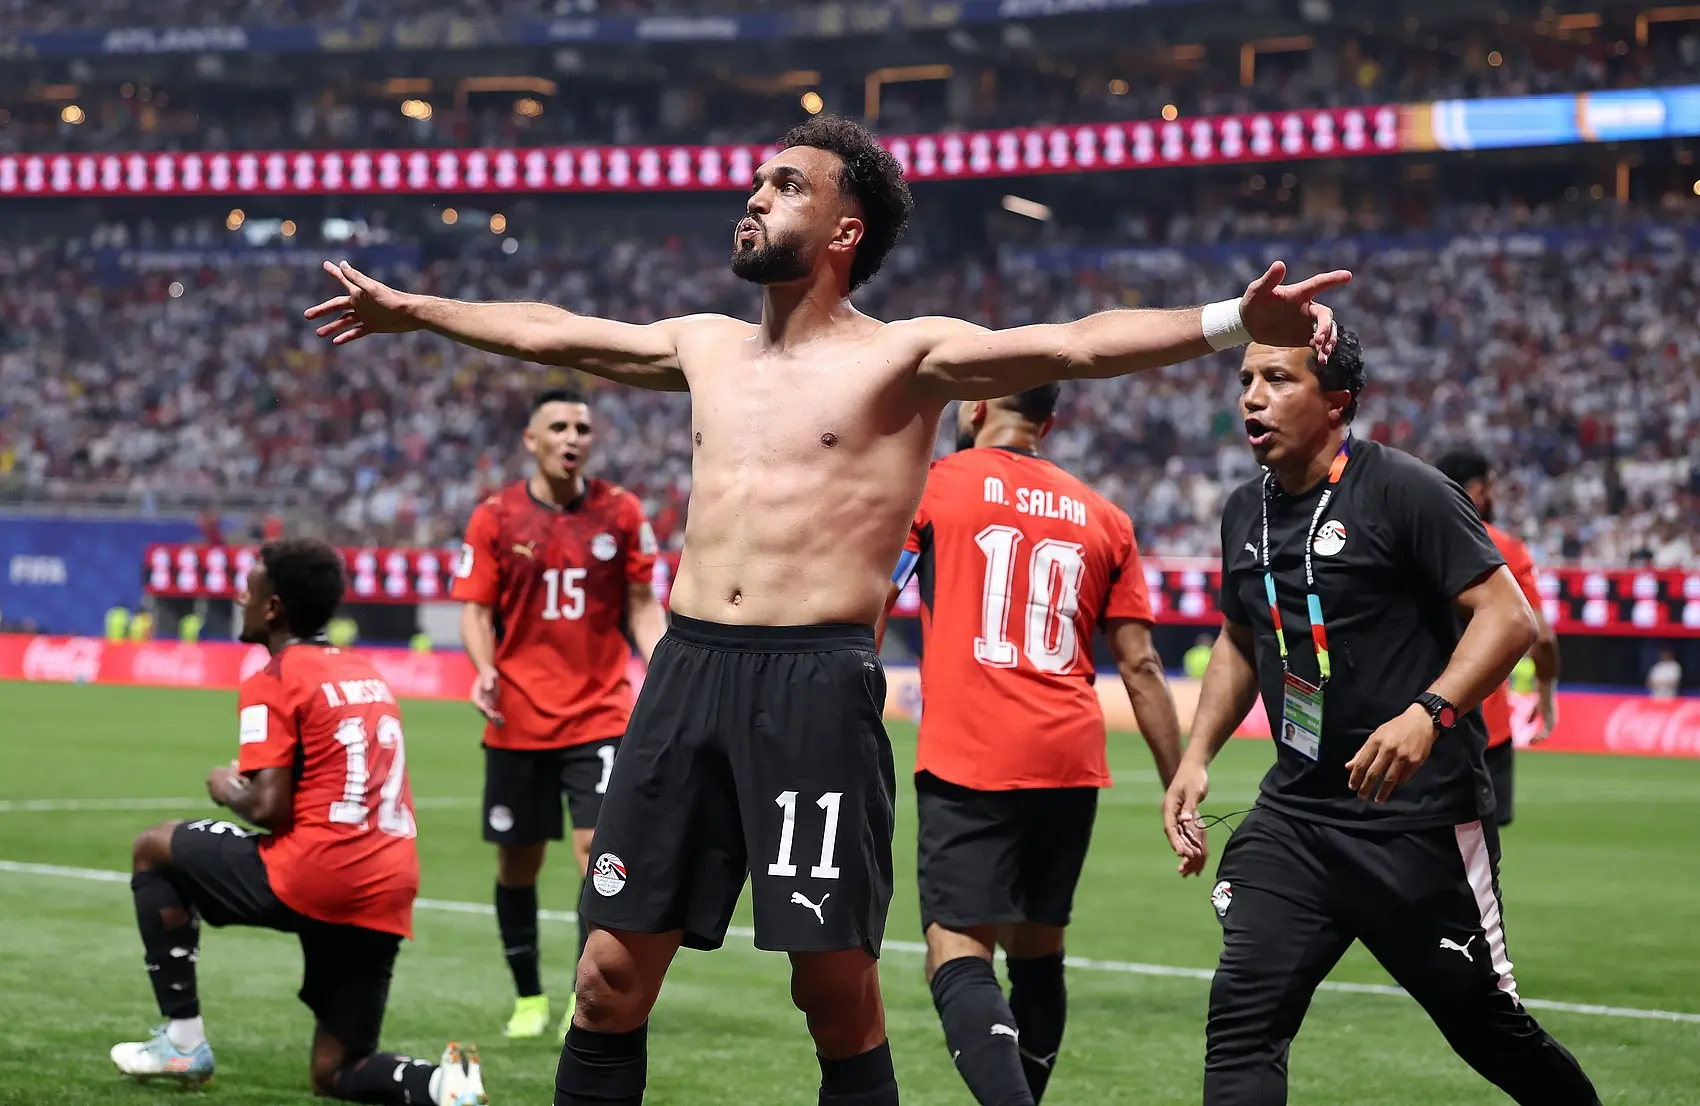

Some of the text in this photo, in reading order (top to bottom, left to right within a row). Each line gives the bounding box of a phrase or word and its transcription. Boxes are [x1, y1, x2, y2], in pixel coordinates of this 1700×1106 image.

[984, 476, 1086, 527] M. SALAH
[1309, 506, 1325, 536] WORLD
[1318, 489, 1332, 508] FIFA
[1305, 535, 1313, 554] CUP
[9, 554, 67, 586] FIFA
[541, 567, 588, 620] 15
[973, 523, 1087, 675] 10
[329, 714, 418, 839] 12
[595, 745, 616, 794] 1
[767, 790, 844, 879] 11
